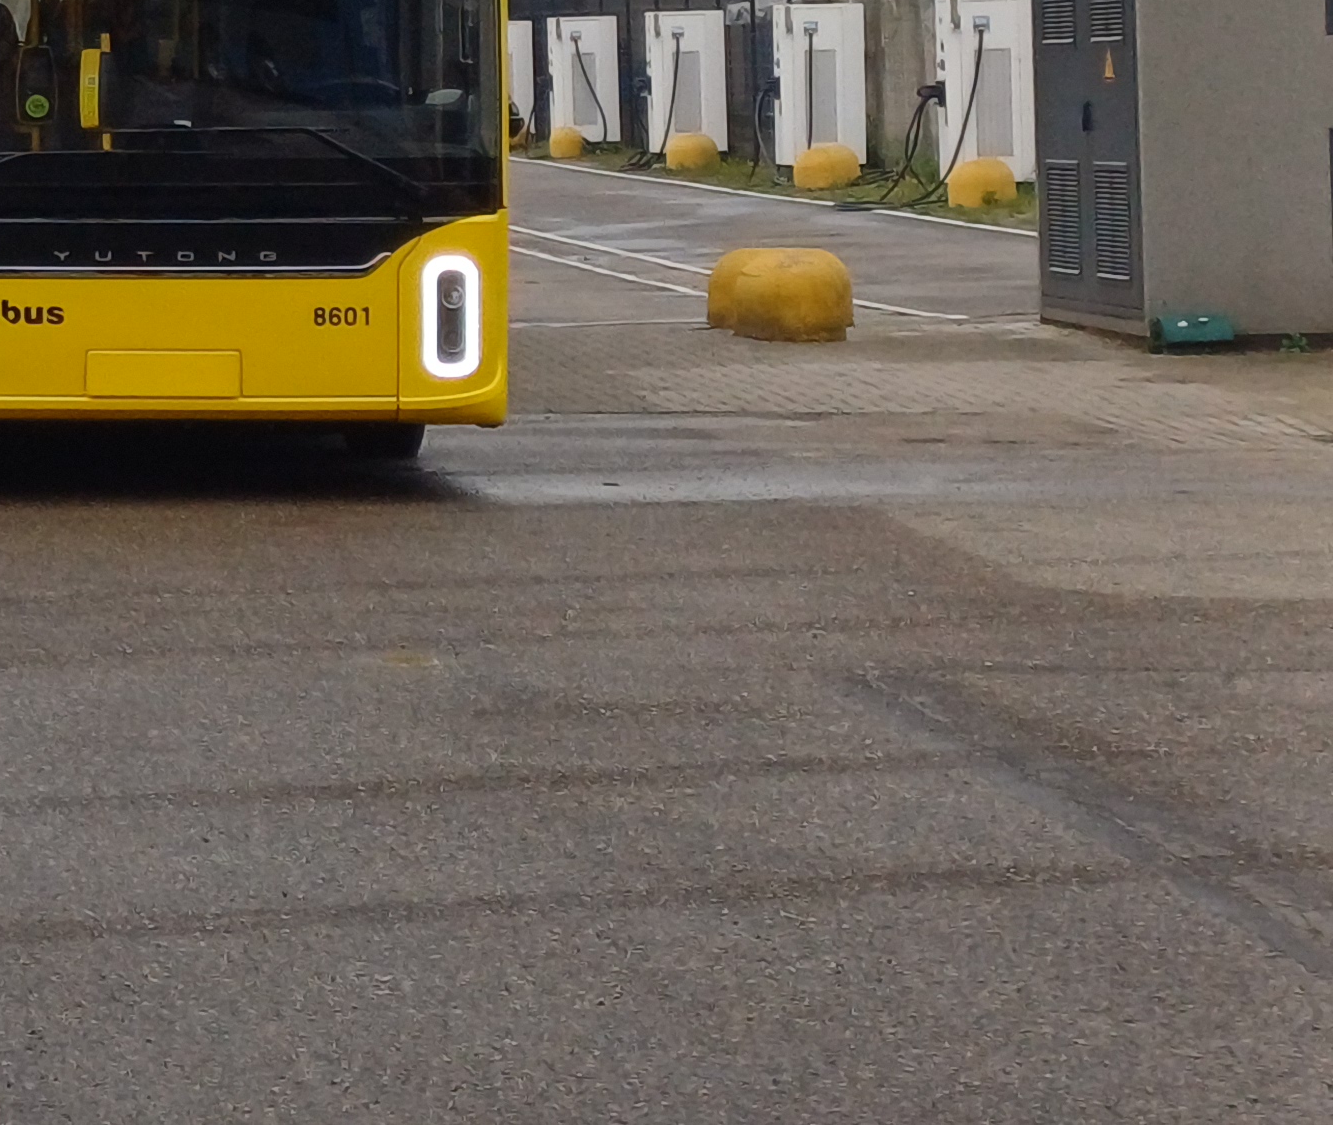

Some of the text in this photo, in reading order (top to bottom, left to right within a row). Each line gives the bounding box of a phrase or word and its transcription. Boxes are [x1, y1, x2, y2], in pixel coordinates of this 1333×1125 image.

[53, 250, 278, 262] YUTONG
[1, 299, 65, 325] bus
[313, 305, 371, 327] 8601
